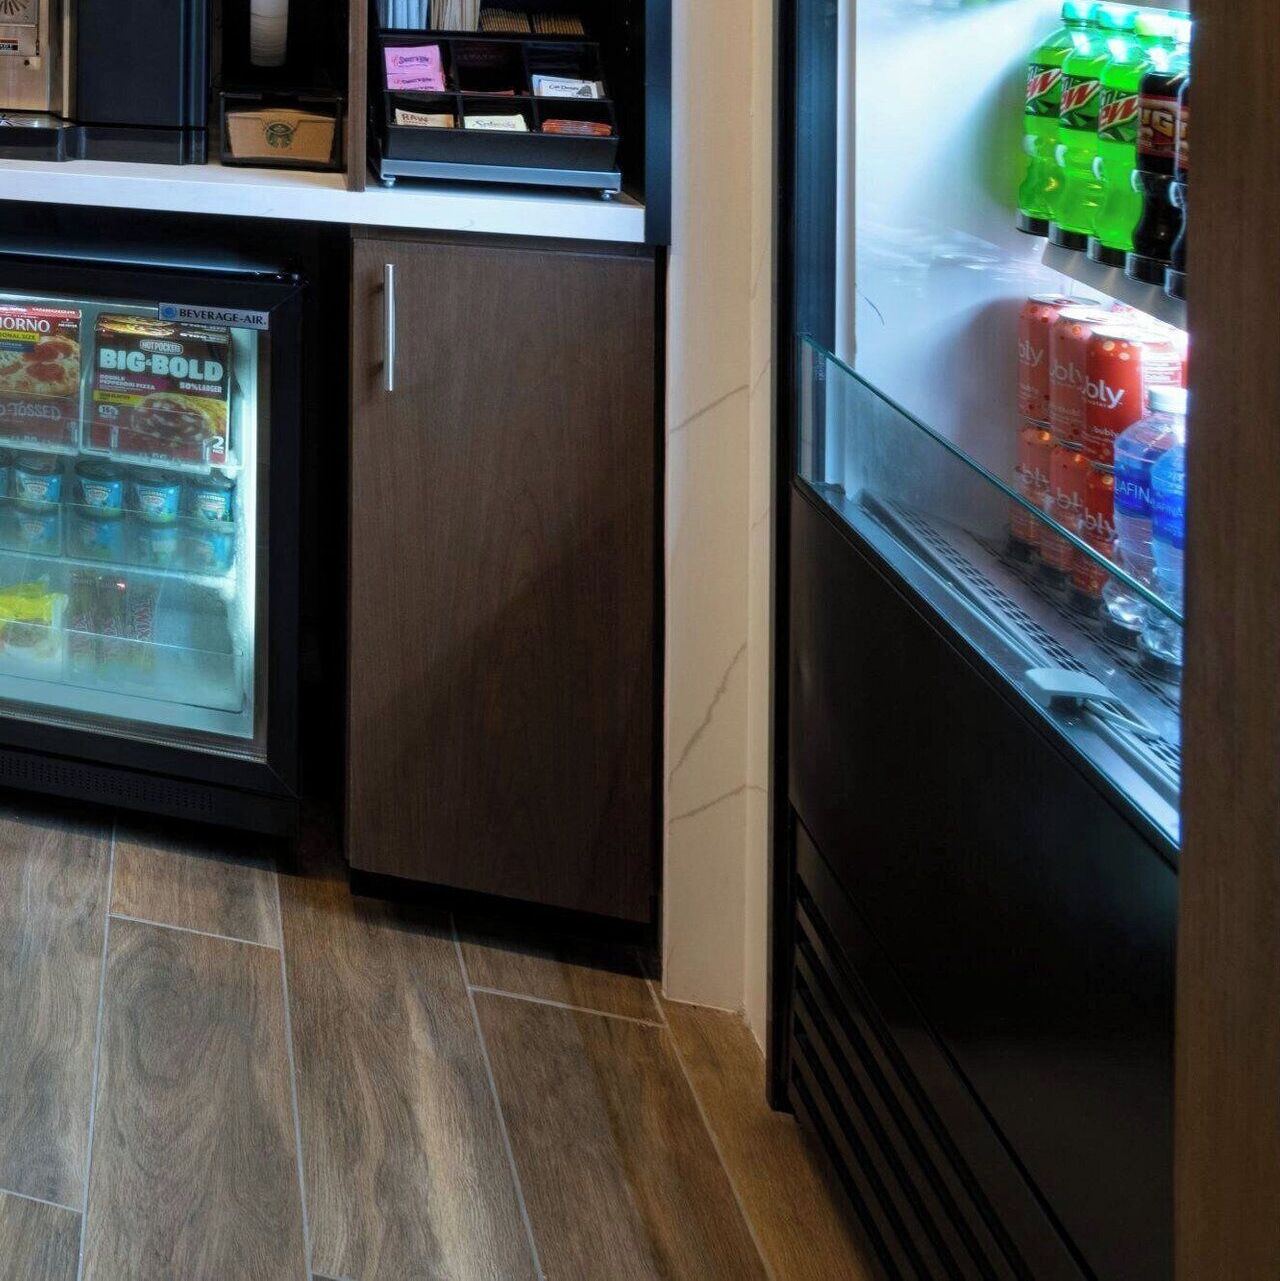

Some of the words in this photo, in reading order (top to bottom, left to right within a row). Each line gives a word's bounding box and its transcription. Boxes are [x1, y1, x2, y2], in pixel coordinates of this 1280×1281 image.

[401, 113, 429, 123] RAW
[99, 348, 146, 373] BIG
[151, 354, 224, 382] BOLD
[197, 383, 222, 393] LARGER
[212, 435, 224, 450] 2
